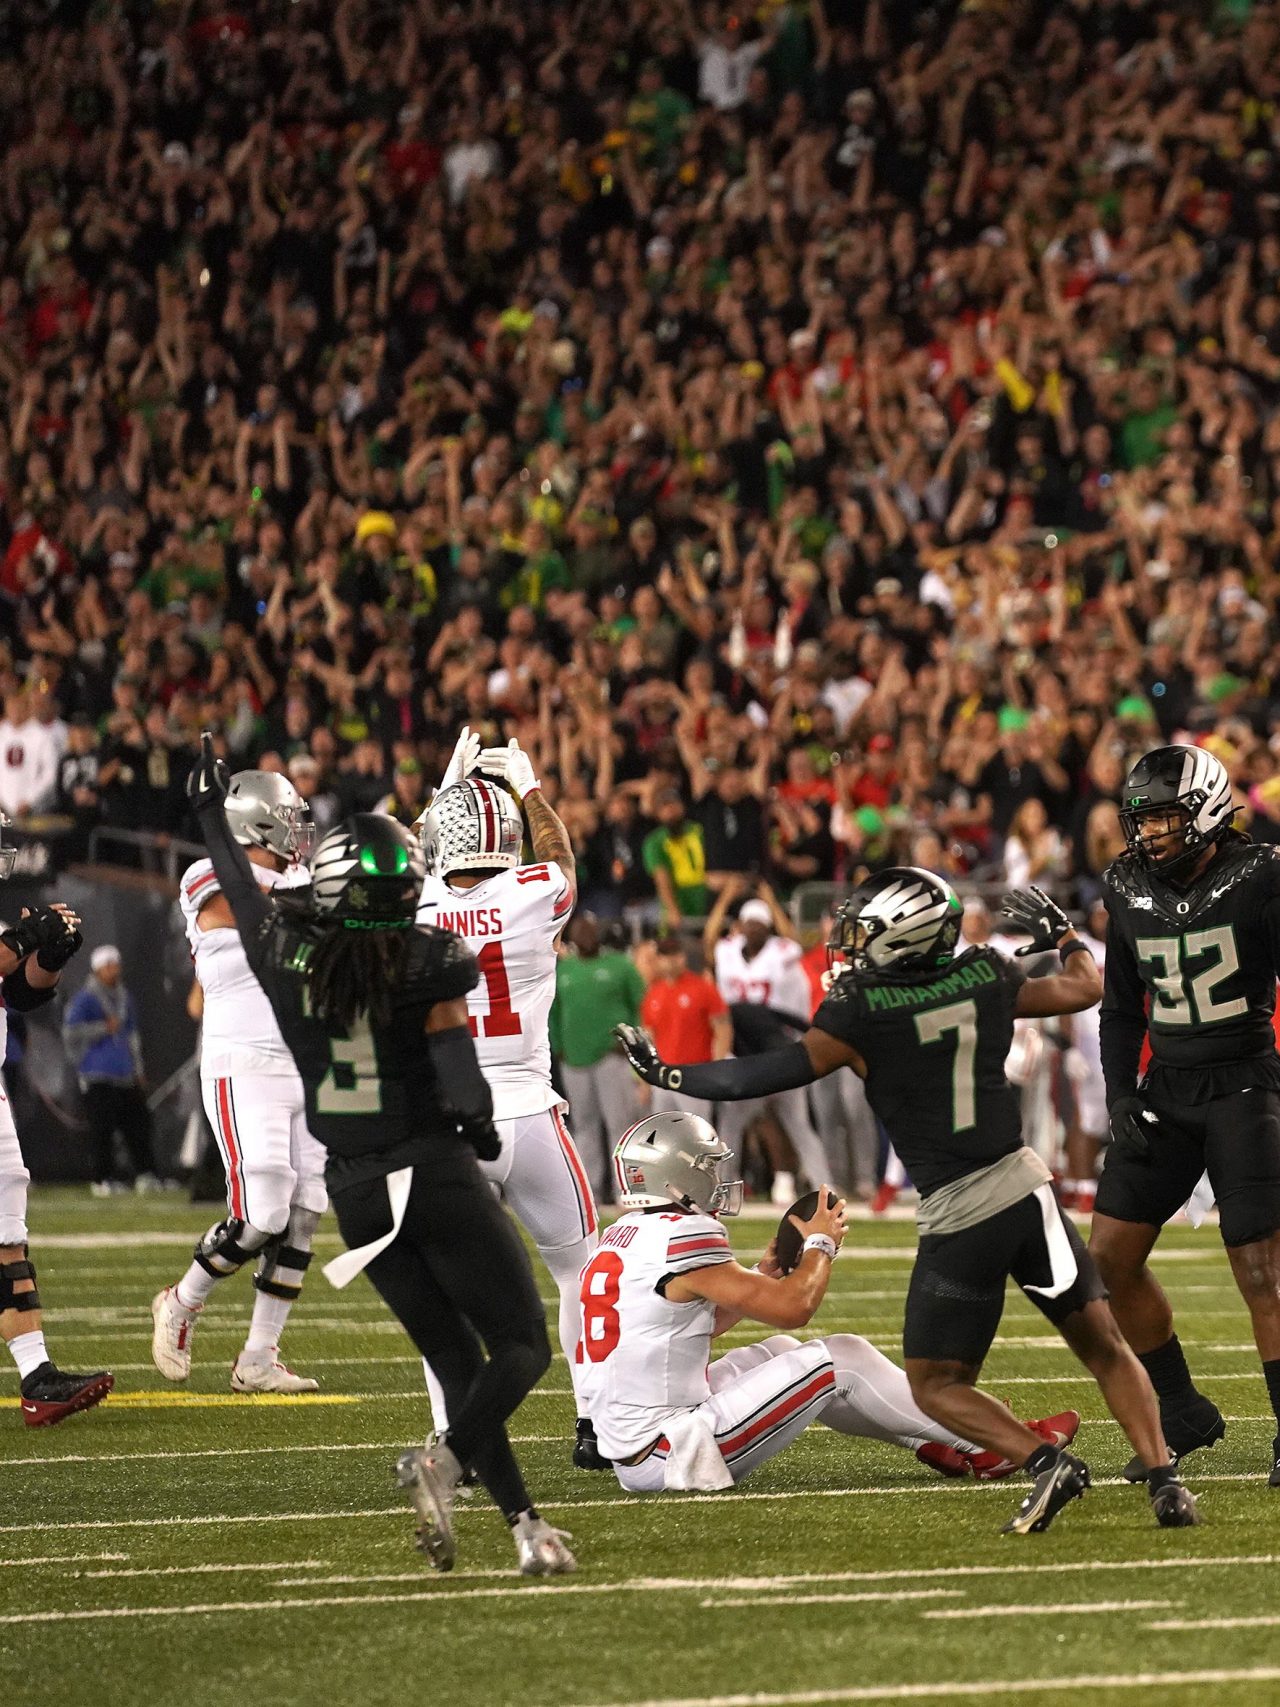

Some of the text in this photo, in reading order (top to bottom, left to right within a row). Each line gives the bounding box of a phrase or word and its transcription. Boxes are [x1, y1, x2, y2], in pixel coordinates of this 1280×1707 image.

[515, 864, 551, 885] 11
[436, 908, 502, 938] INNISS
[1176, 902, 1190, 914] O
[467, 941, 523, 1038] 1
[864, 959, 997, 1012] MUHAMMAD
[1135, 922, 1249, 1026] 32
[913, 998, 978, 1135] 7
